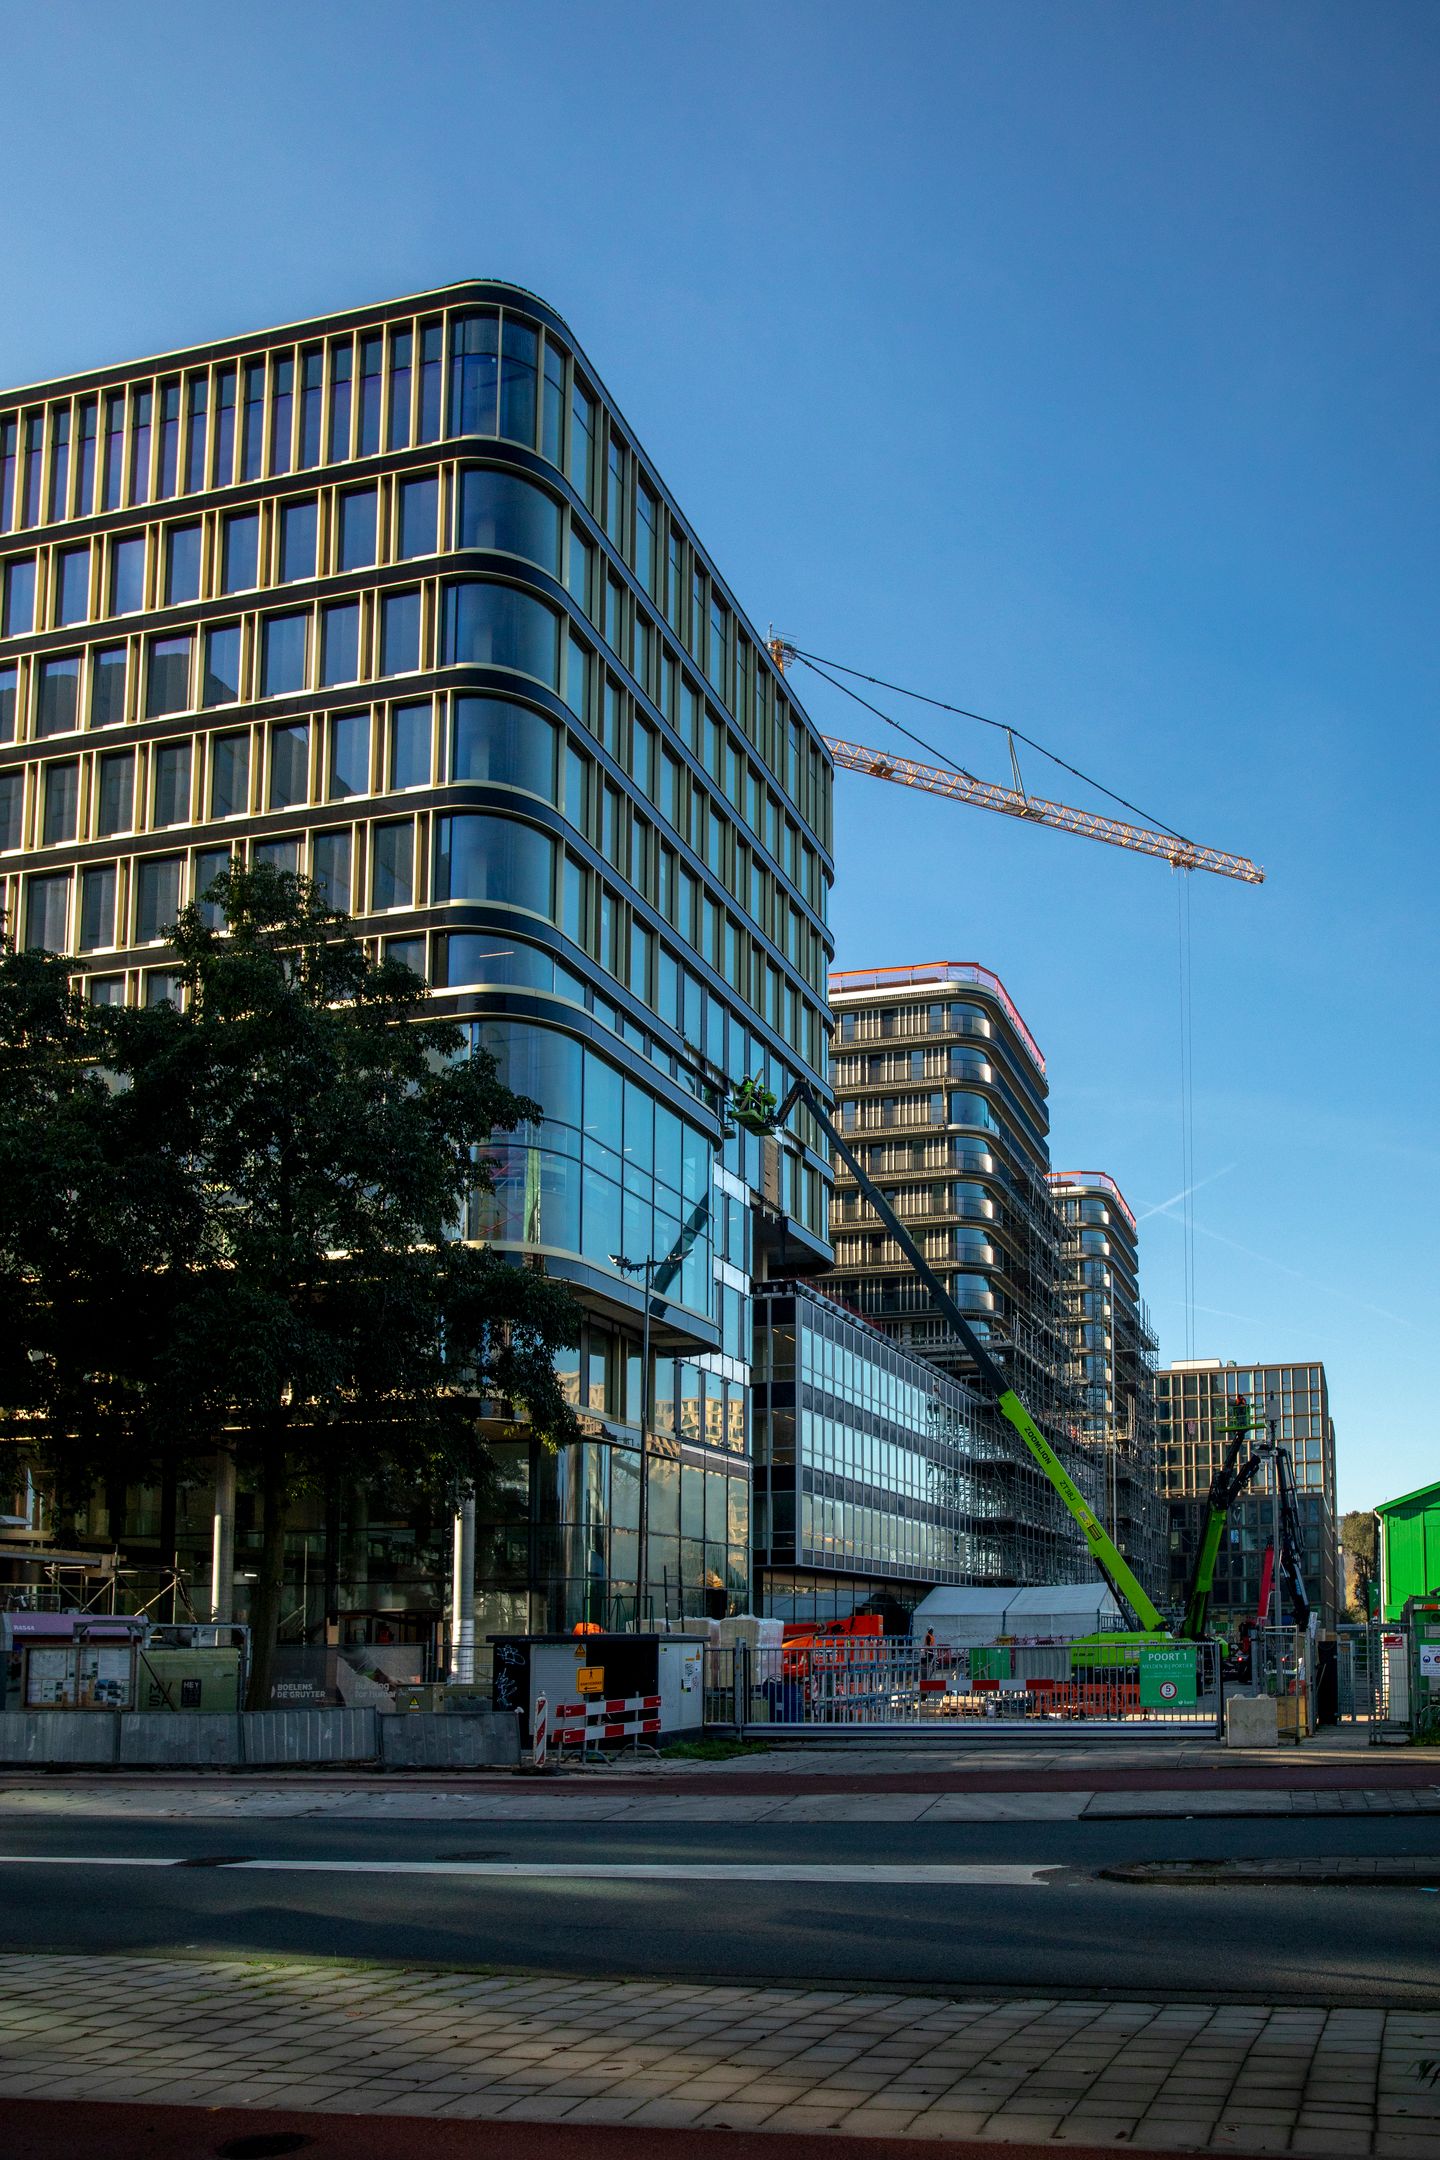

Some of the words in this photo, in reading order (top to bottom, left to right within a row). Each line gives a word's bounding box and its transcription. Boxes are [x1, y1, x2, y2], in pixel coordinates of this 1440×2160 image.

[1024, 1426, 1052, 1465] ZOOMLION
[1060, 1480, 1076, 1502] ZT38J
[1148, 1652, 1180, 1661] POORT
[1183, 1652, 1187, 1661] 1
[277, 1683, 313, 1691] BOELENS
[355, 1682, 390, 1692] Building
[1165, 1685, 1171, 1693] 5
